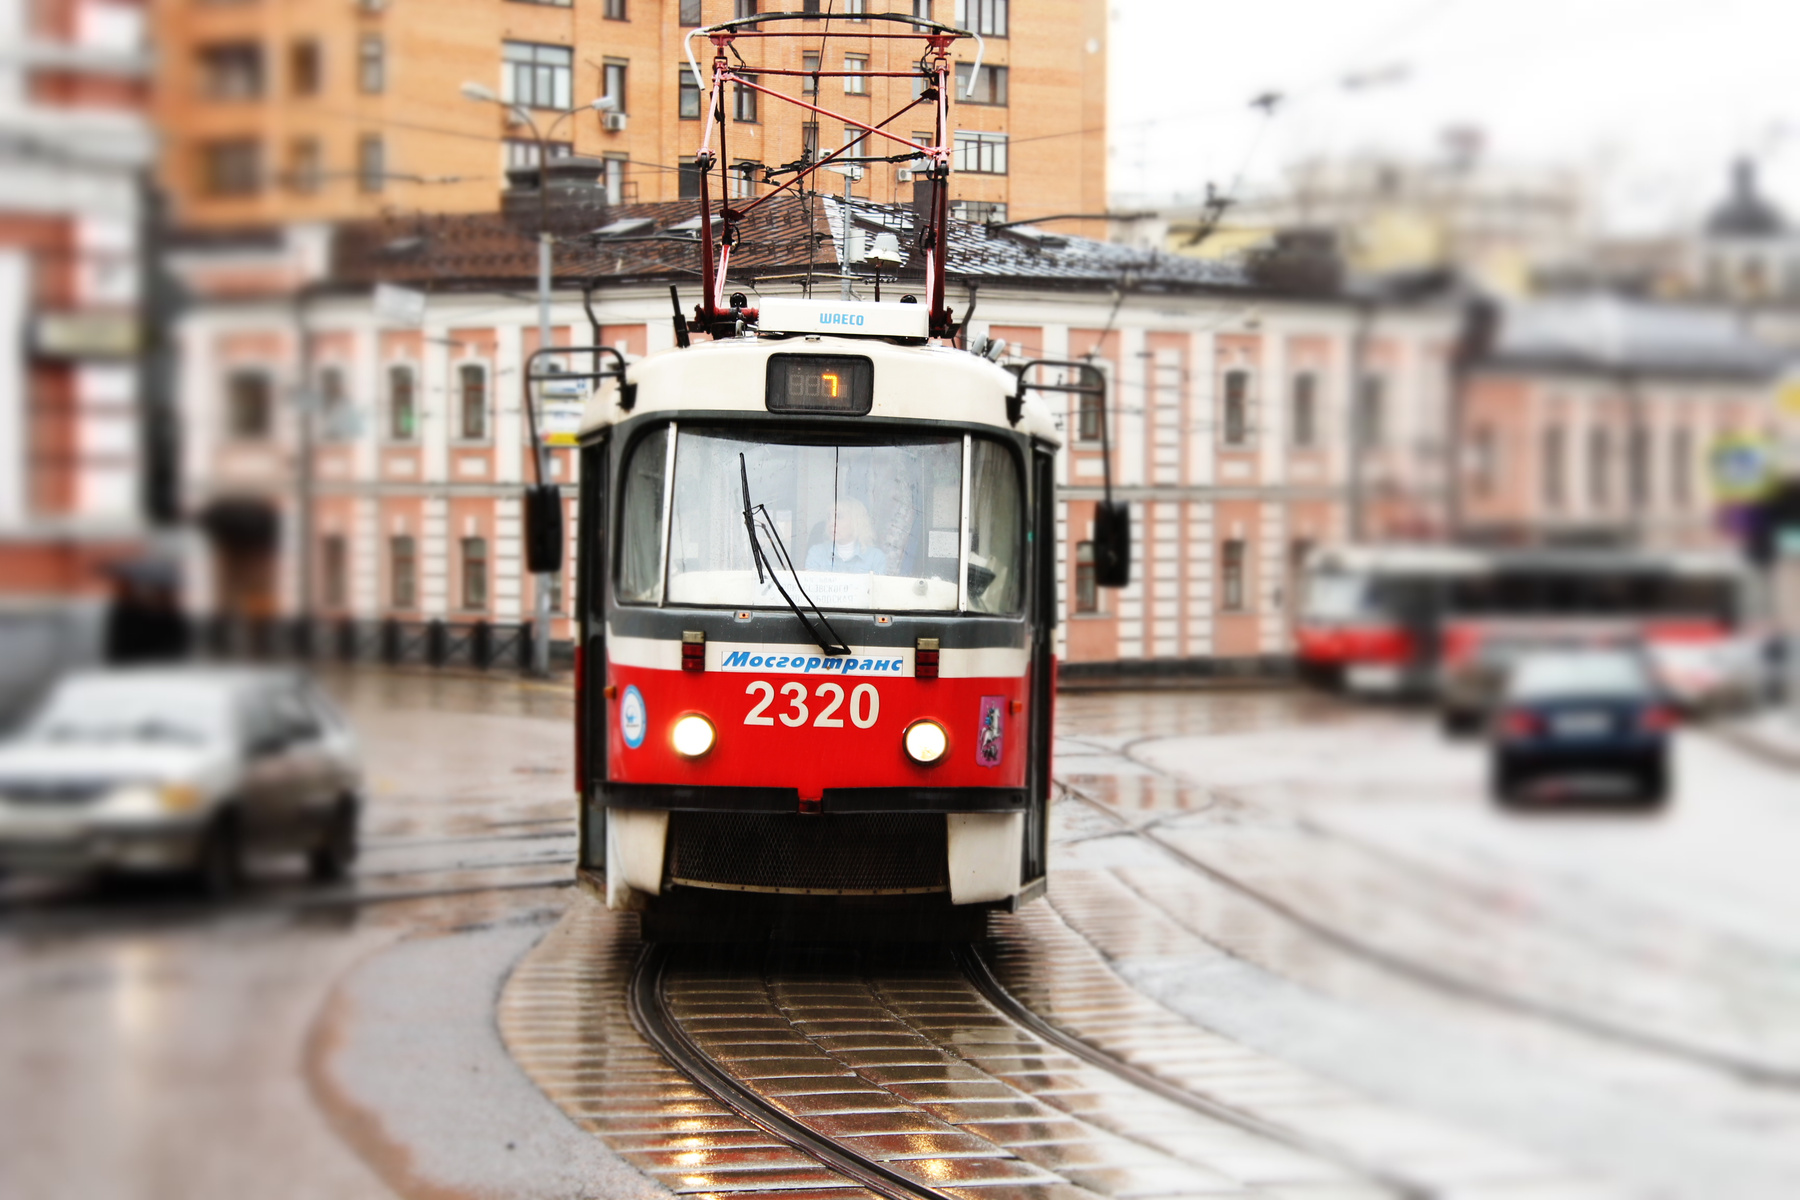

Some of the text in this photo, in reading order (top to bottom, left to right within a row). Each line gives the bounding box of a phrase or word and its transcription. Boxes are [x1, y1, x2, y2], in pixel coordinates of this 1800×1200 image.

[820, 313, 864, 326] WAECO
[822, 374, 839, 397] 7
[722, 651, 903, 674] Мосгортранс
[743, 680, 880, 729] 2320
